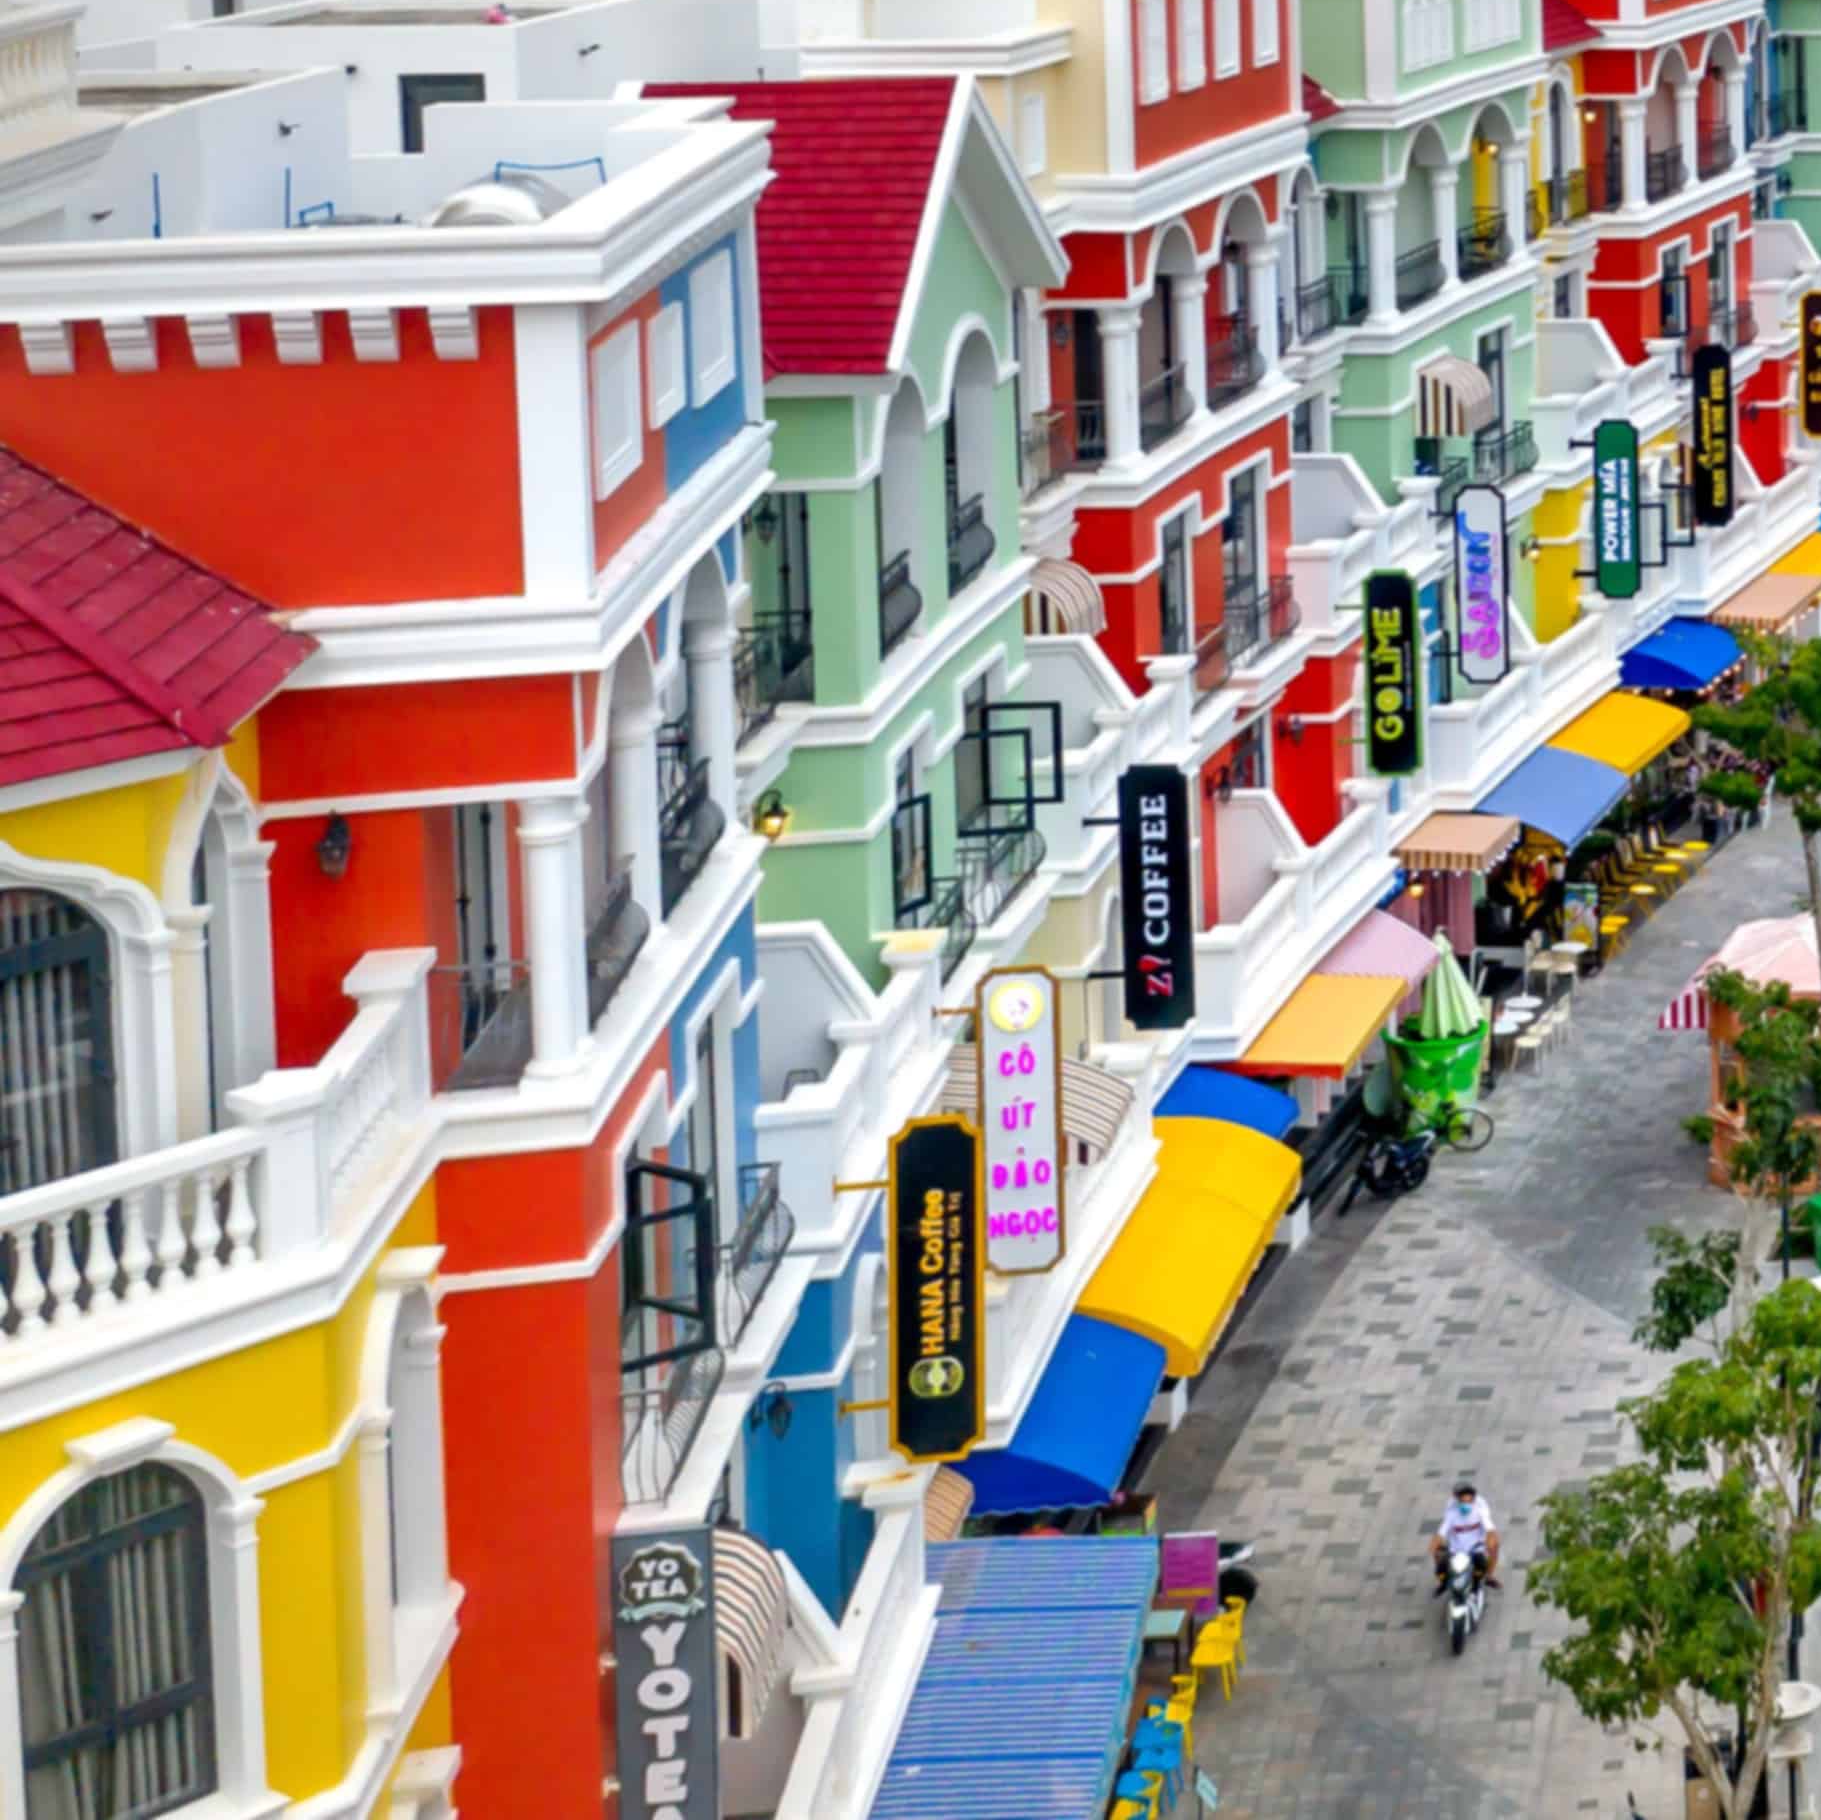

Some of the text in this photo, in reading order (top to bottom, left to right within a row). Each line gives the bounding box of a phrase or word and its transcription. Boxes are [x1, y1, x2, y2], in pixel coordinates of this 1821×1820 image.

[1598, 457, 1619, 562] POWER MÍA
[1139, 793, 1172, 946] COFFEE
[998, 1041, 1036, 1077] CÔ
[987, 1206, 1060, 1243] NGỌC
[919, 1187, 946, 1357] HANA Coffee
[638, 1557, 681, 1580] YO
[629, 1579, 689, 1603] TEA
